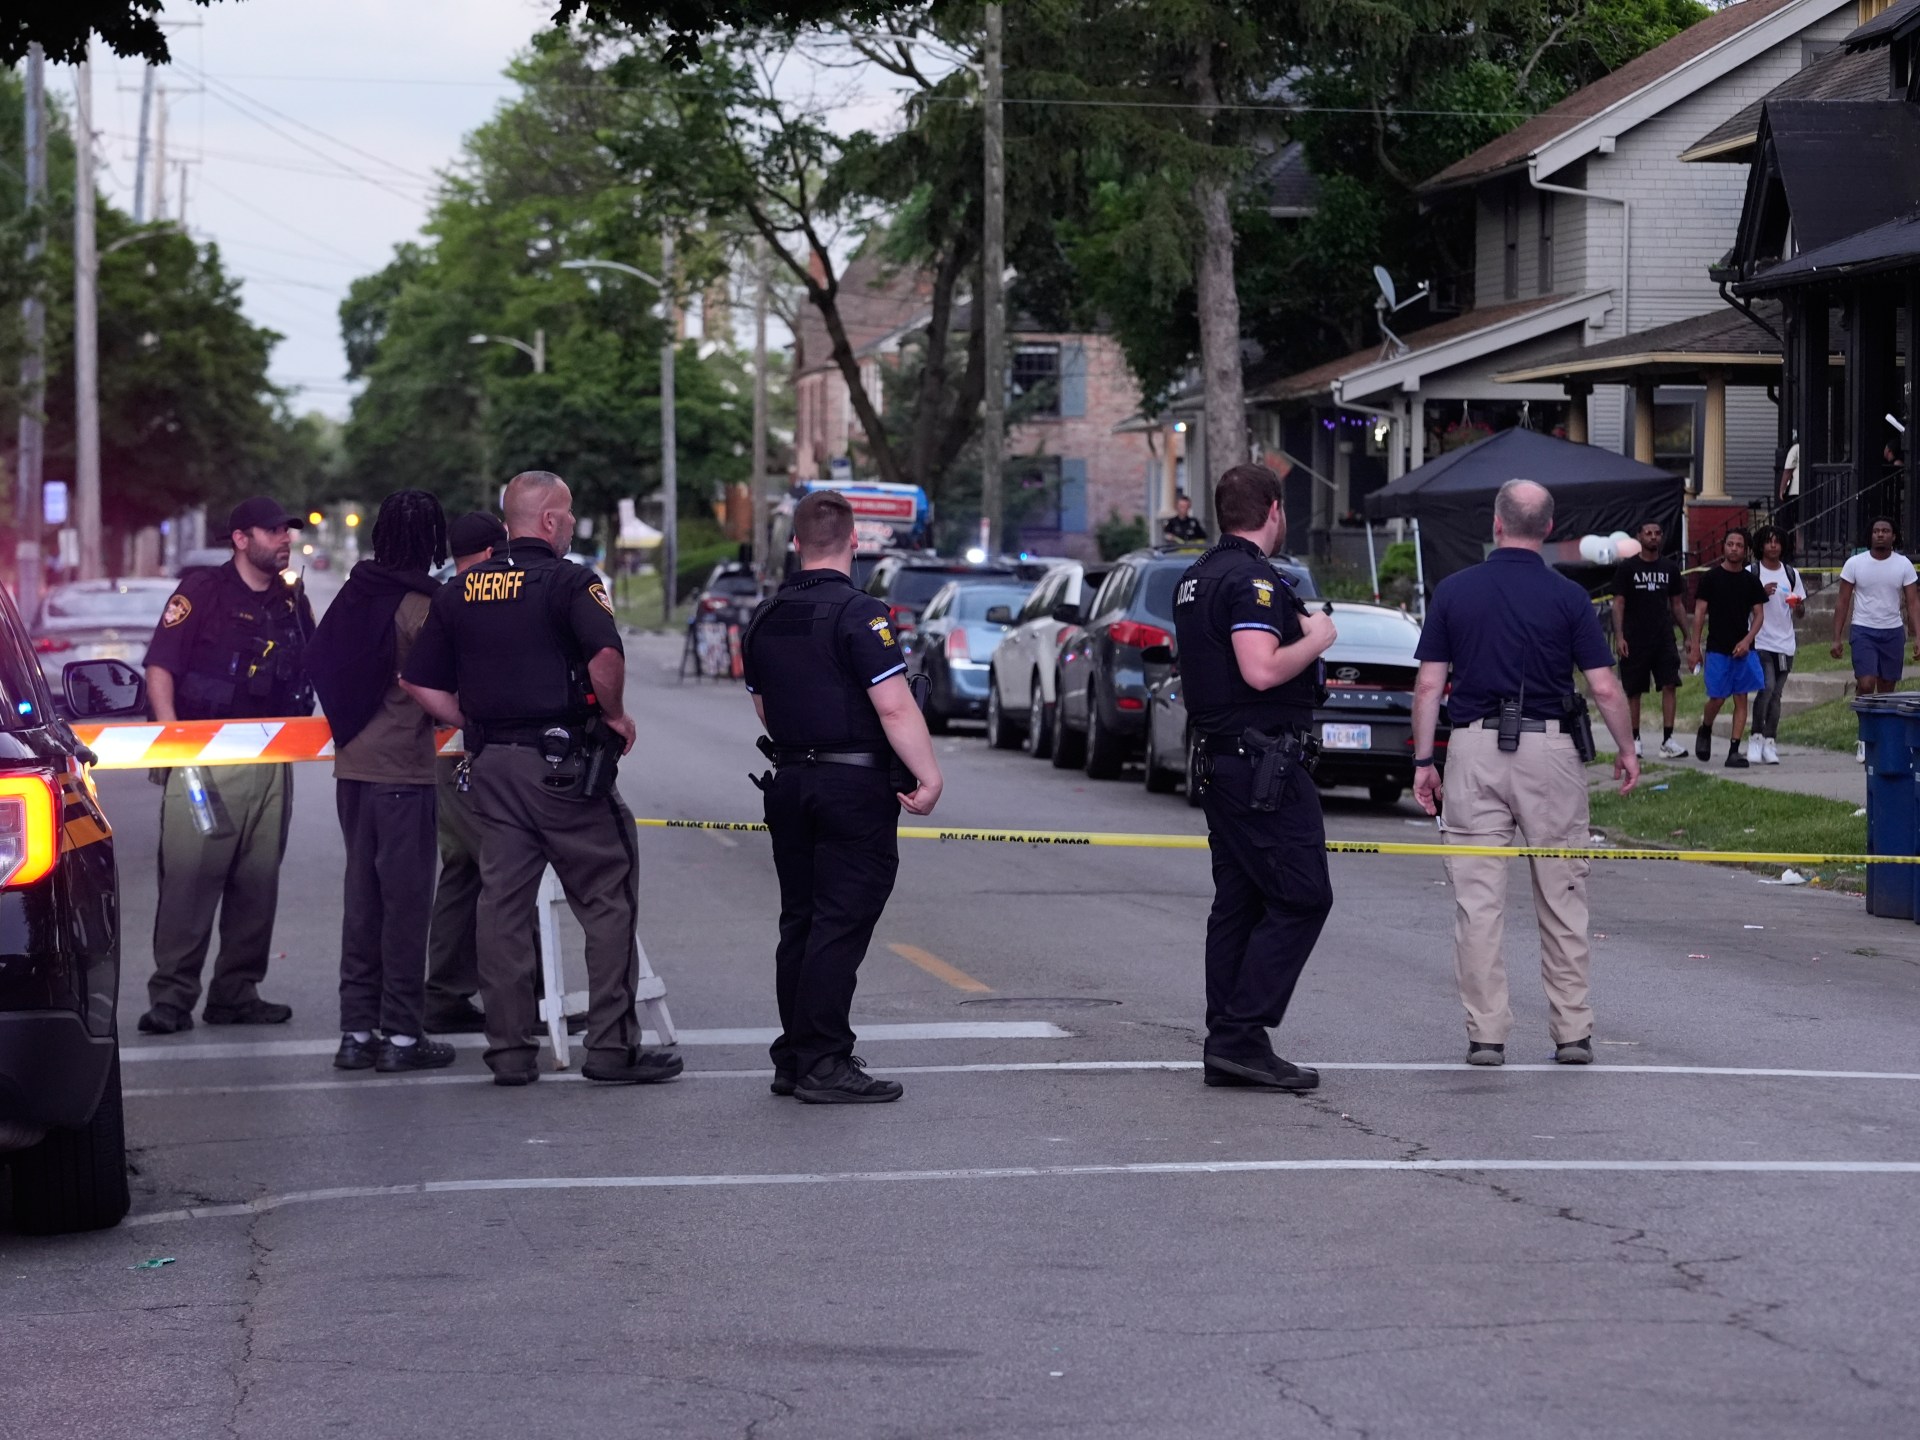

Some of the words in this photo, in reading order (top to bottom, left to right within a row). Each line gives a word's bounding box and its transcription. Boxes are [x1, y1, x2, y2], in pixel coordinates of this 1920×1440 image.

[464, 571, 524, 602] SHERIFF
[1633, 571, 1669, 584] AMIRI
[1176, 579, 1198, 606] OLICE
[1330, 692, 1393, 702] ANTRA
